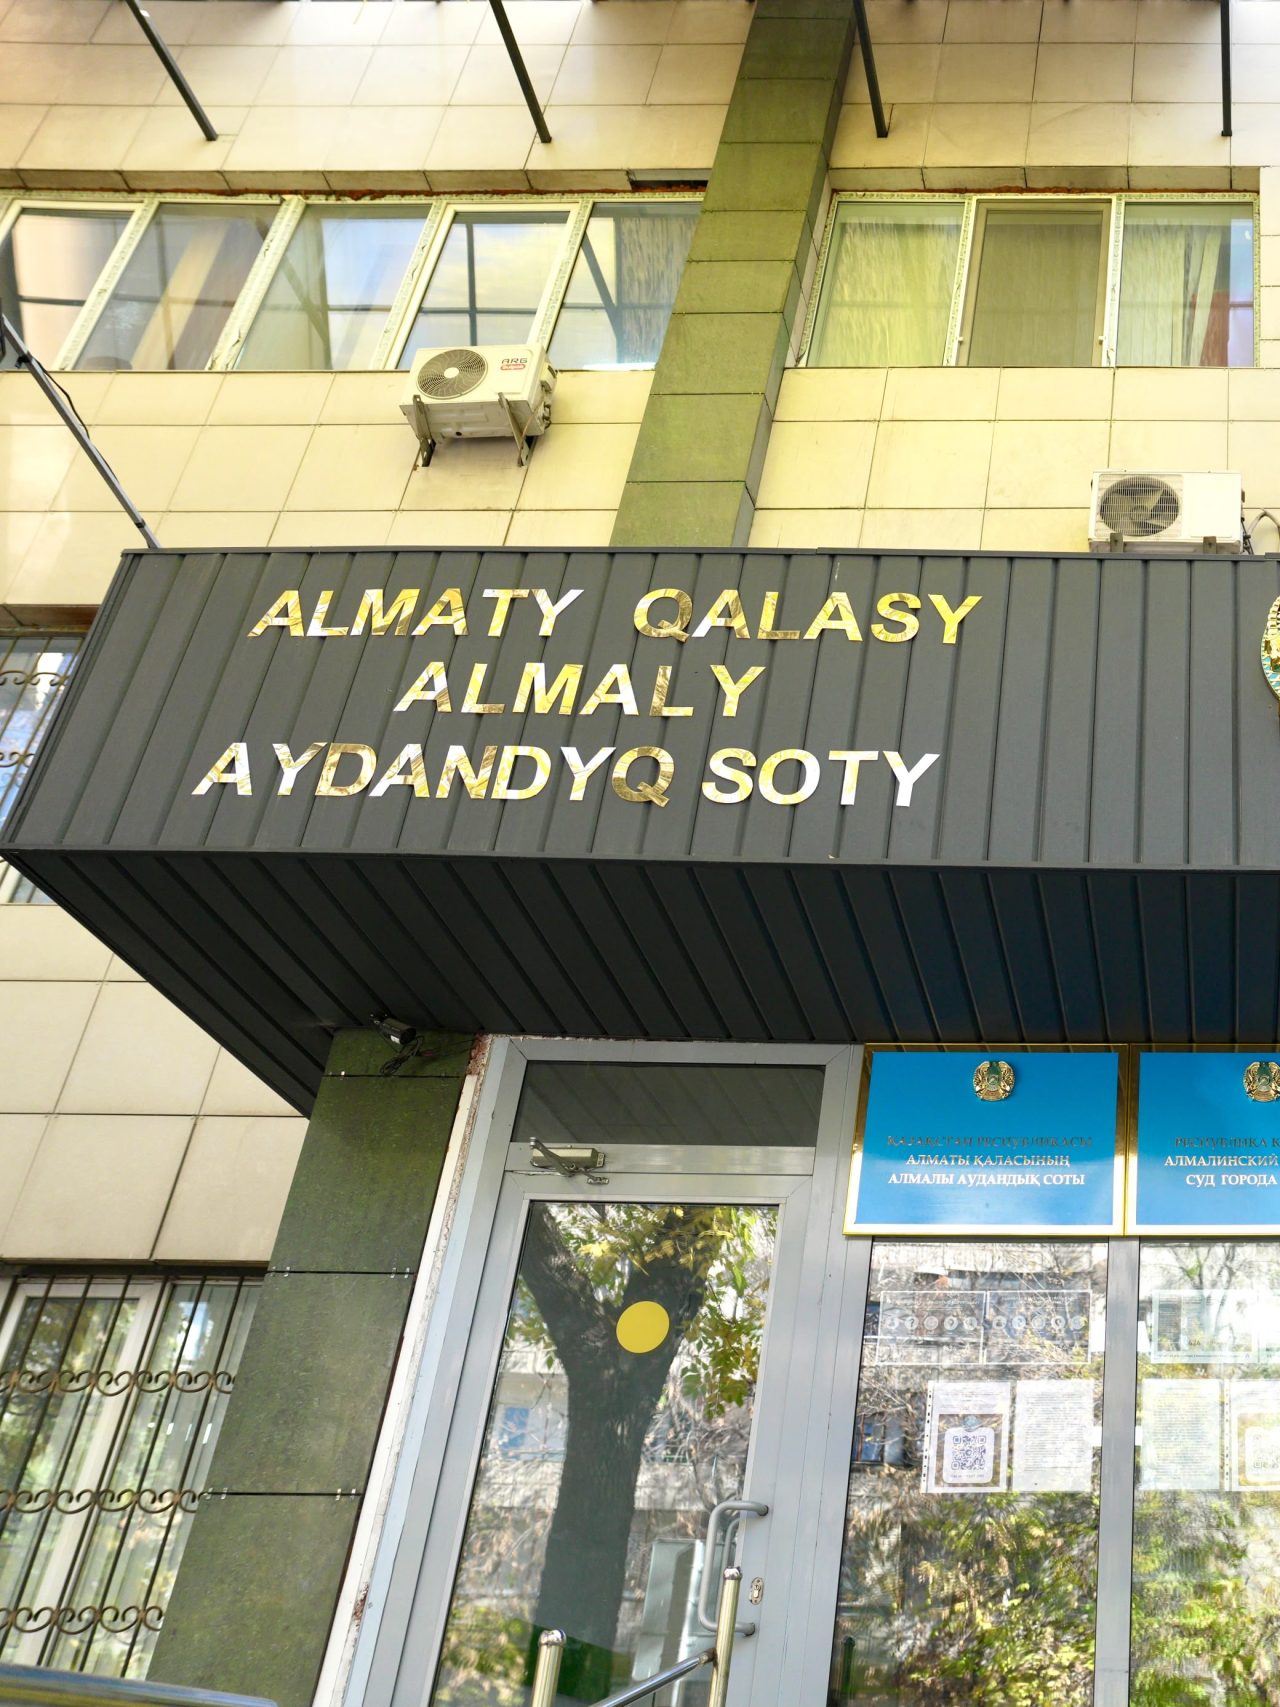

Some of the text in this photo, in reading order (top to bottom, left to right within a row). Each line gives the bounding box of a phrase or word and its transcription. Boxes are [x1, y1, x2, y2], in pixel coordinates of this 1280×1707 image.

[248, 588, 982, 644] ALMATY QALASY
[393, 661, 766, 718] ALMALY
[191, 742, 940, 808] AYDANDYQ SOTY
[1175, 1136, 1268, 1149] РЕСПУБЛИКА
[905, 1154, 1070, 1168] АЛМАТЫ ҚАЛАСЫНЫҢ
[1164, 1153, 1279, 1167] АЛМАЛИНСКИЙ
[888, 1173, 1085, 1187] АЛМАЛЫ АУДАНДЫҚ СОТЫ
[1185, 1174, 1215, 1188] СУД
[1221, 1174, 1277, 1187] ГОРОДА
